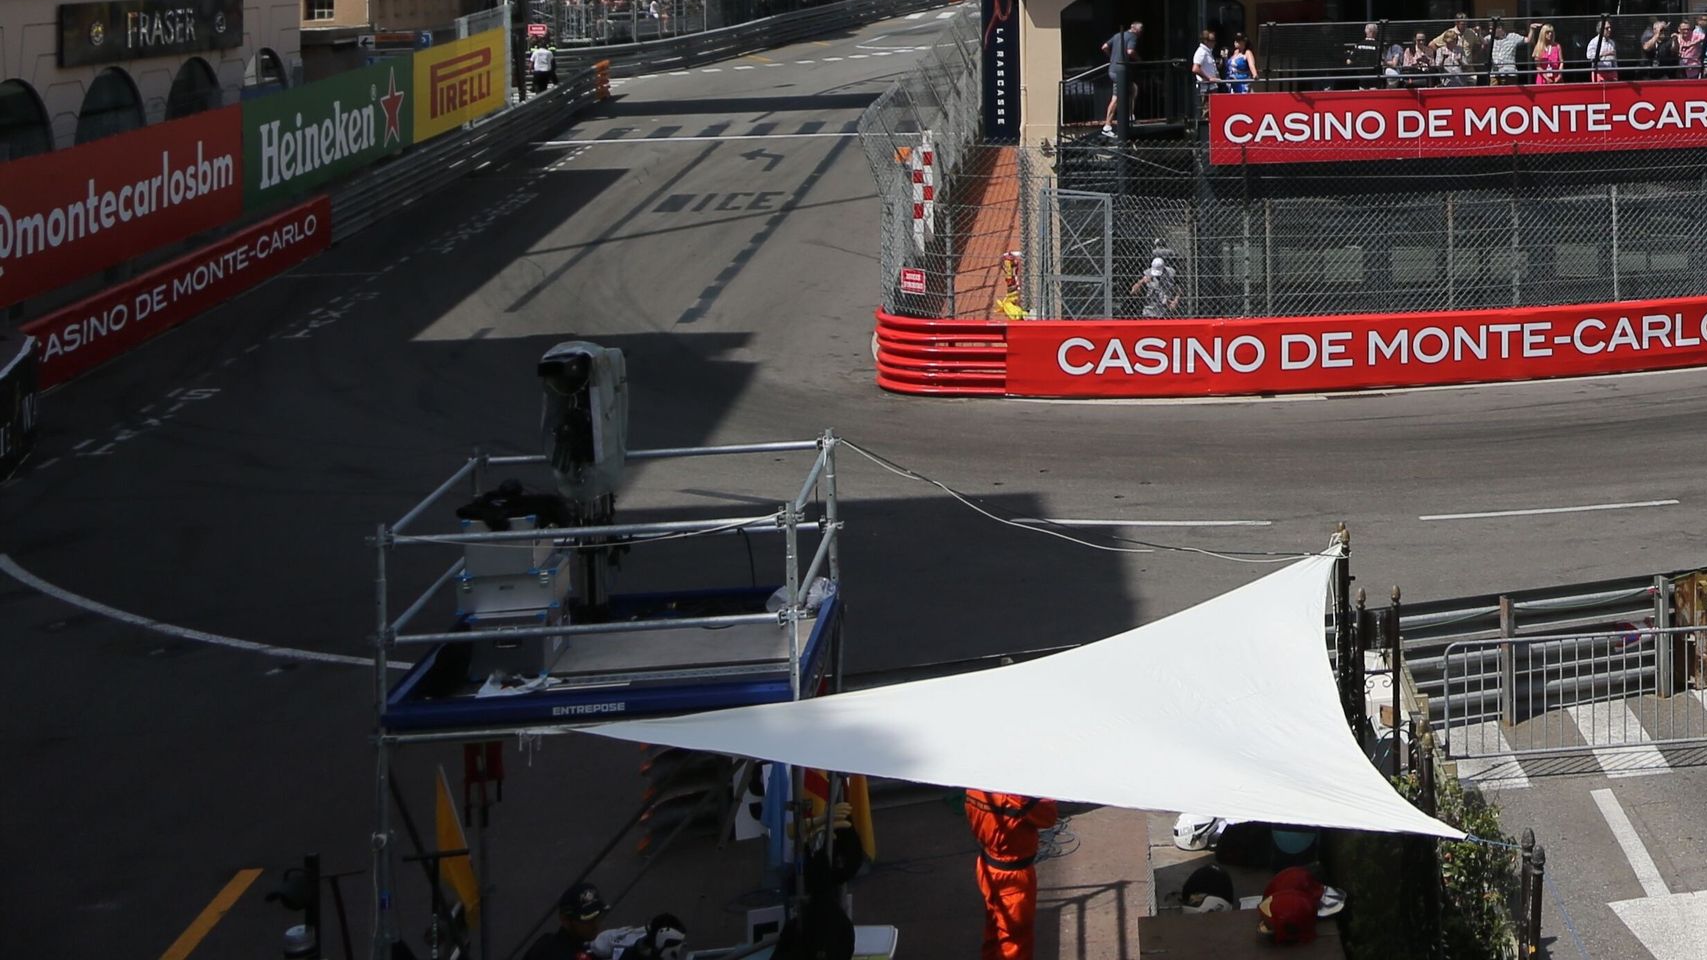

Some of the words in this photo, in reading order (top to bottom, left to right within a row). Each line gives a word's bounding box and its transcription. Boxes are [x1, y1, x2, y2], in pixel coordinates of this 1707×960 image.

[127, 7, 196, 49] FRASER
[996, 27, 1005, 44] LA
[429, 46, 492, 120] PIRELLI
[996, 50, 1006, 125] RASCASSE
[258, 100, 376, 190] Heineken
[1223, 111, 1386, 144] CASINO
[1397, 109, 1454, 138] DE
[39, 303, 128, 364] ASINO
[135, 283, 168, 322] DE
[172, 213, 318, 303] MONTE-CARLO
[1057, 335, 1266, 376] CASINO
[1280, 331, 1354, 371] DE
[552, 702, 626, 716] ENTREPOSE
